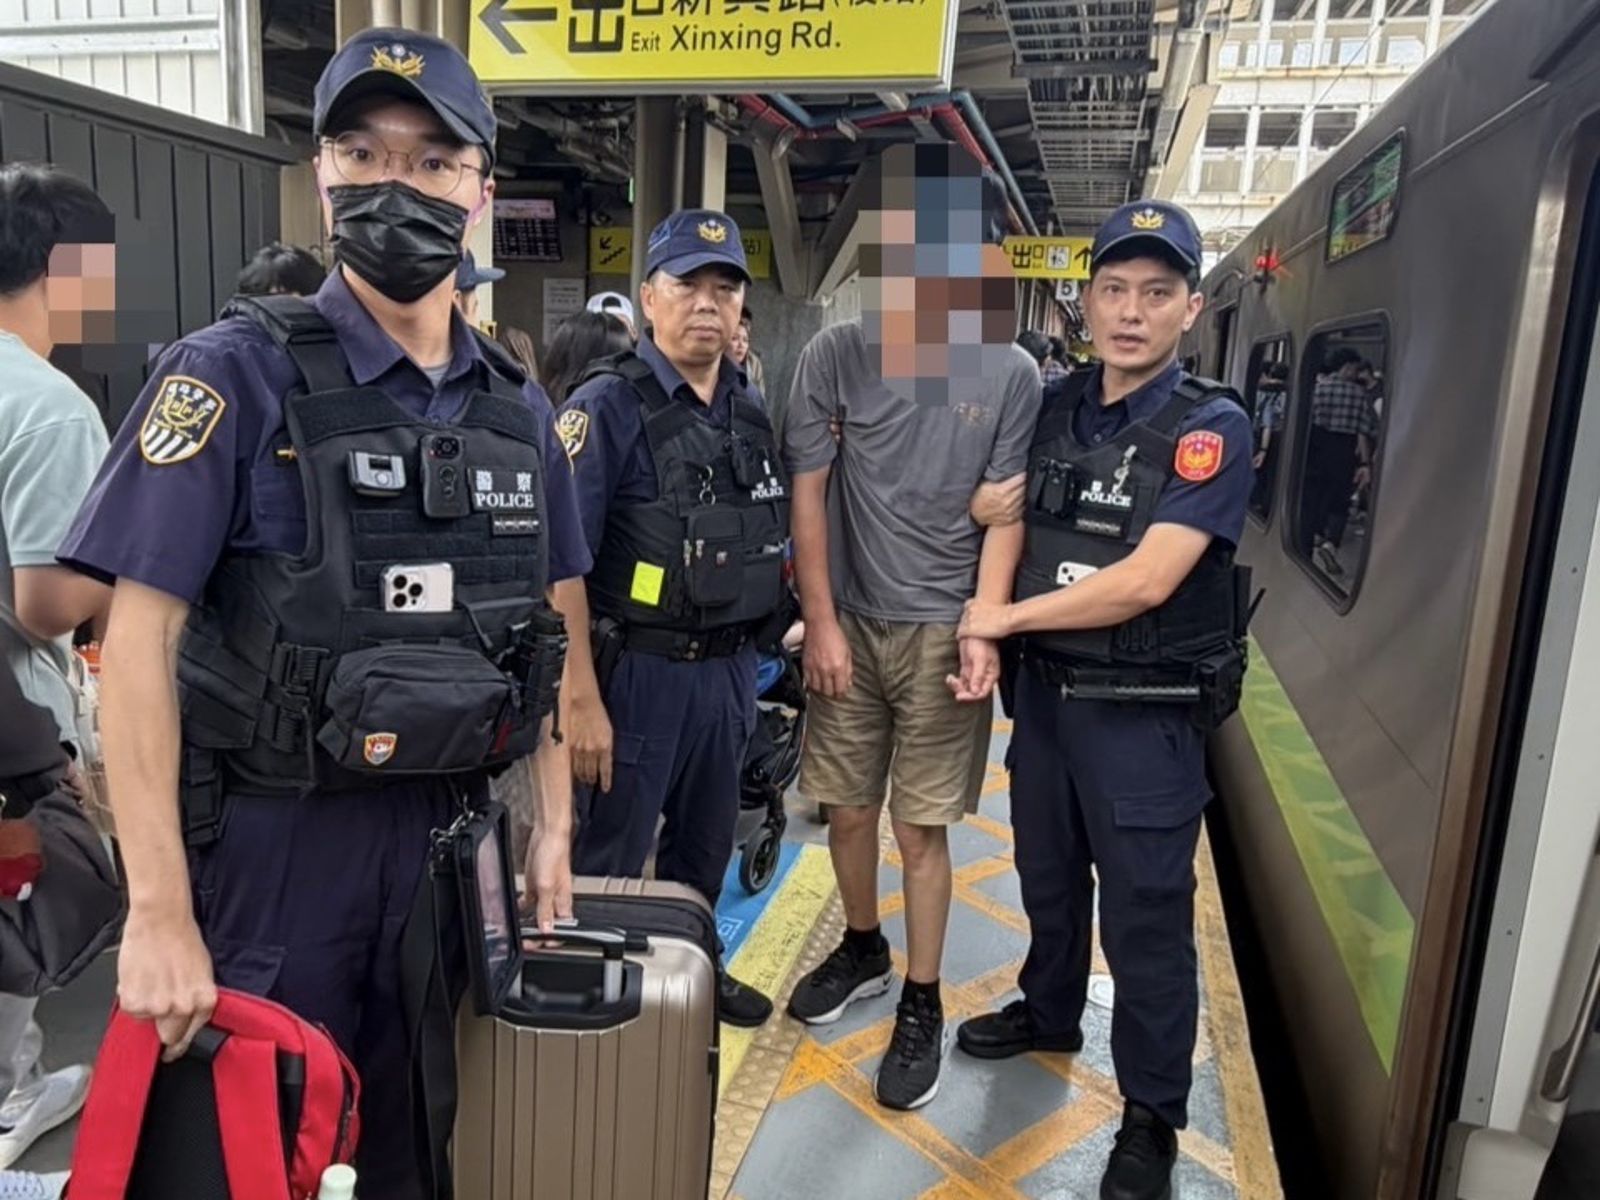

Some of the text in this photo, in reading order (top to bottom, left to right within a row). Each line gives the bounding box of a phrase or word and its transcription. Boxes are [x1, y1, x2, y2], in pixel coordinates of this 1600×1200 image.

[631, 20, 841, 56] Exit Xinxing Rd.
[1012, 243, 1044, 269] 出口
[475, 492, 535, 508] POLICE
[1080, 490, 1132, 508] POLICE
